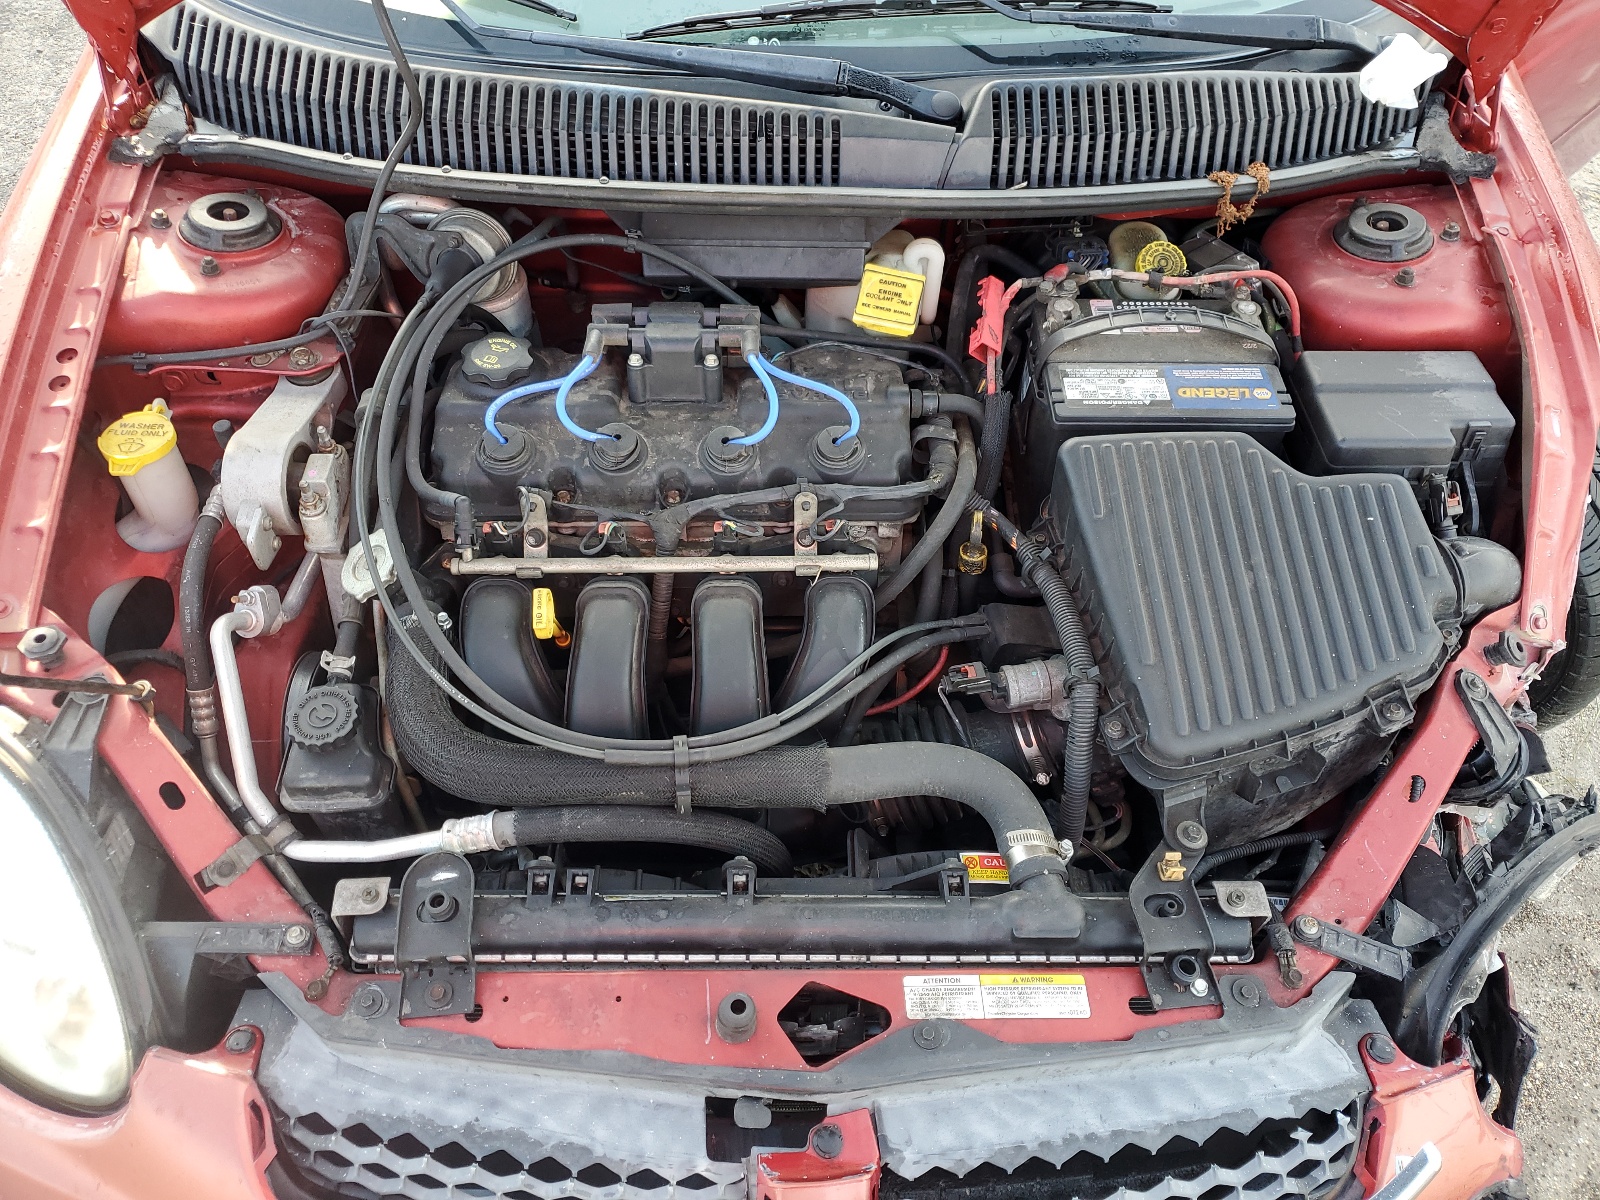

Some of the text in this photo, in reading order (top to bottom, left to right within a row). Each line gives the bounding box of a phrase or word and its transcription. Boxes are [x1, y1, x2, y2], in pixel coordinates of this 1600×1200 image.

[878, 278, 907, 289] CAUTION
[878, 288, 903, 298] ENGINE
[865, 292, 913, 307] COOLANT ONLY
[893, 309, 912, 317] MANUAL
[1177, 387, 1251, 399] LEGEND
[119, 422, 165, 430] WASHER
[107, 428, 138, 436] FLUID
[535, 612, 543, 627] OIL
[321, 691, 350, 706] STEERING
[293, 713, 314, 739] APPROVED
